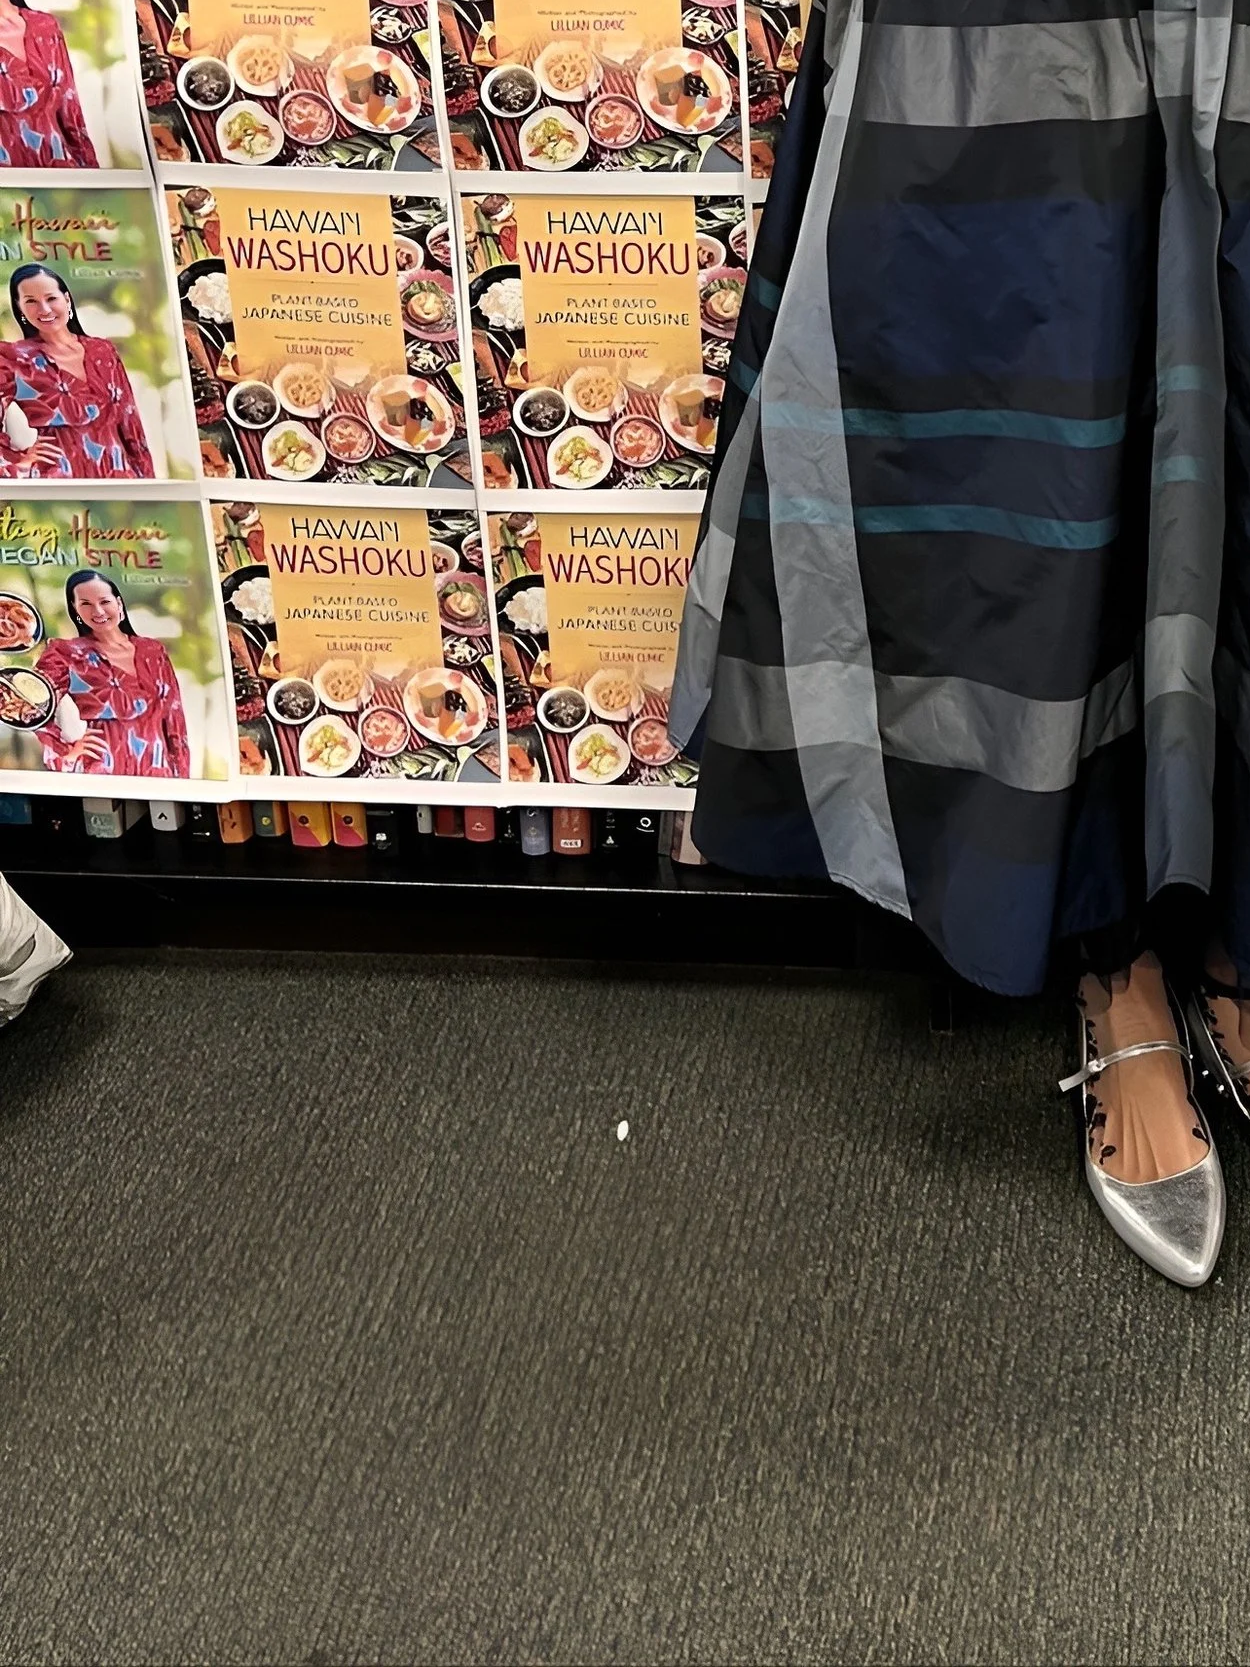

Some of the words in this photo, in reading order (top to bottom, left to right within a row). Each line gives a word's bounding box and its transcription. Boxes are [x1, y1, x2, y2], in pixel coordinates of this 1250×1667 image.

[226, 236, 389, 276] WASHOKU
[524, 242, 690, 276] WASHOKU
[242, 308, 322, 324] JAPANESE
[328, 310, 392, 326] CUISINE
[536, 312, 618, 326] JAPANESE
[624, 312, 690, 326] CUISINE
[270, 544, 426, 578] WASHOKU
[284, 608, 364, 622] JAPANESE
[368, 610, 430, 622] CUISINE
[556, 618, 638, 632] JAPANESE
